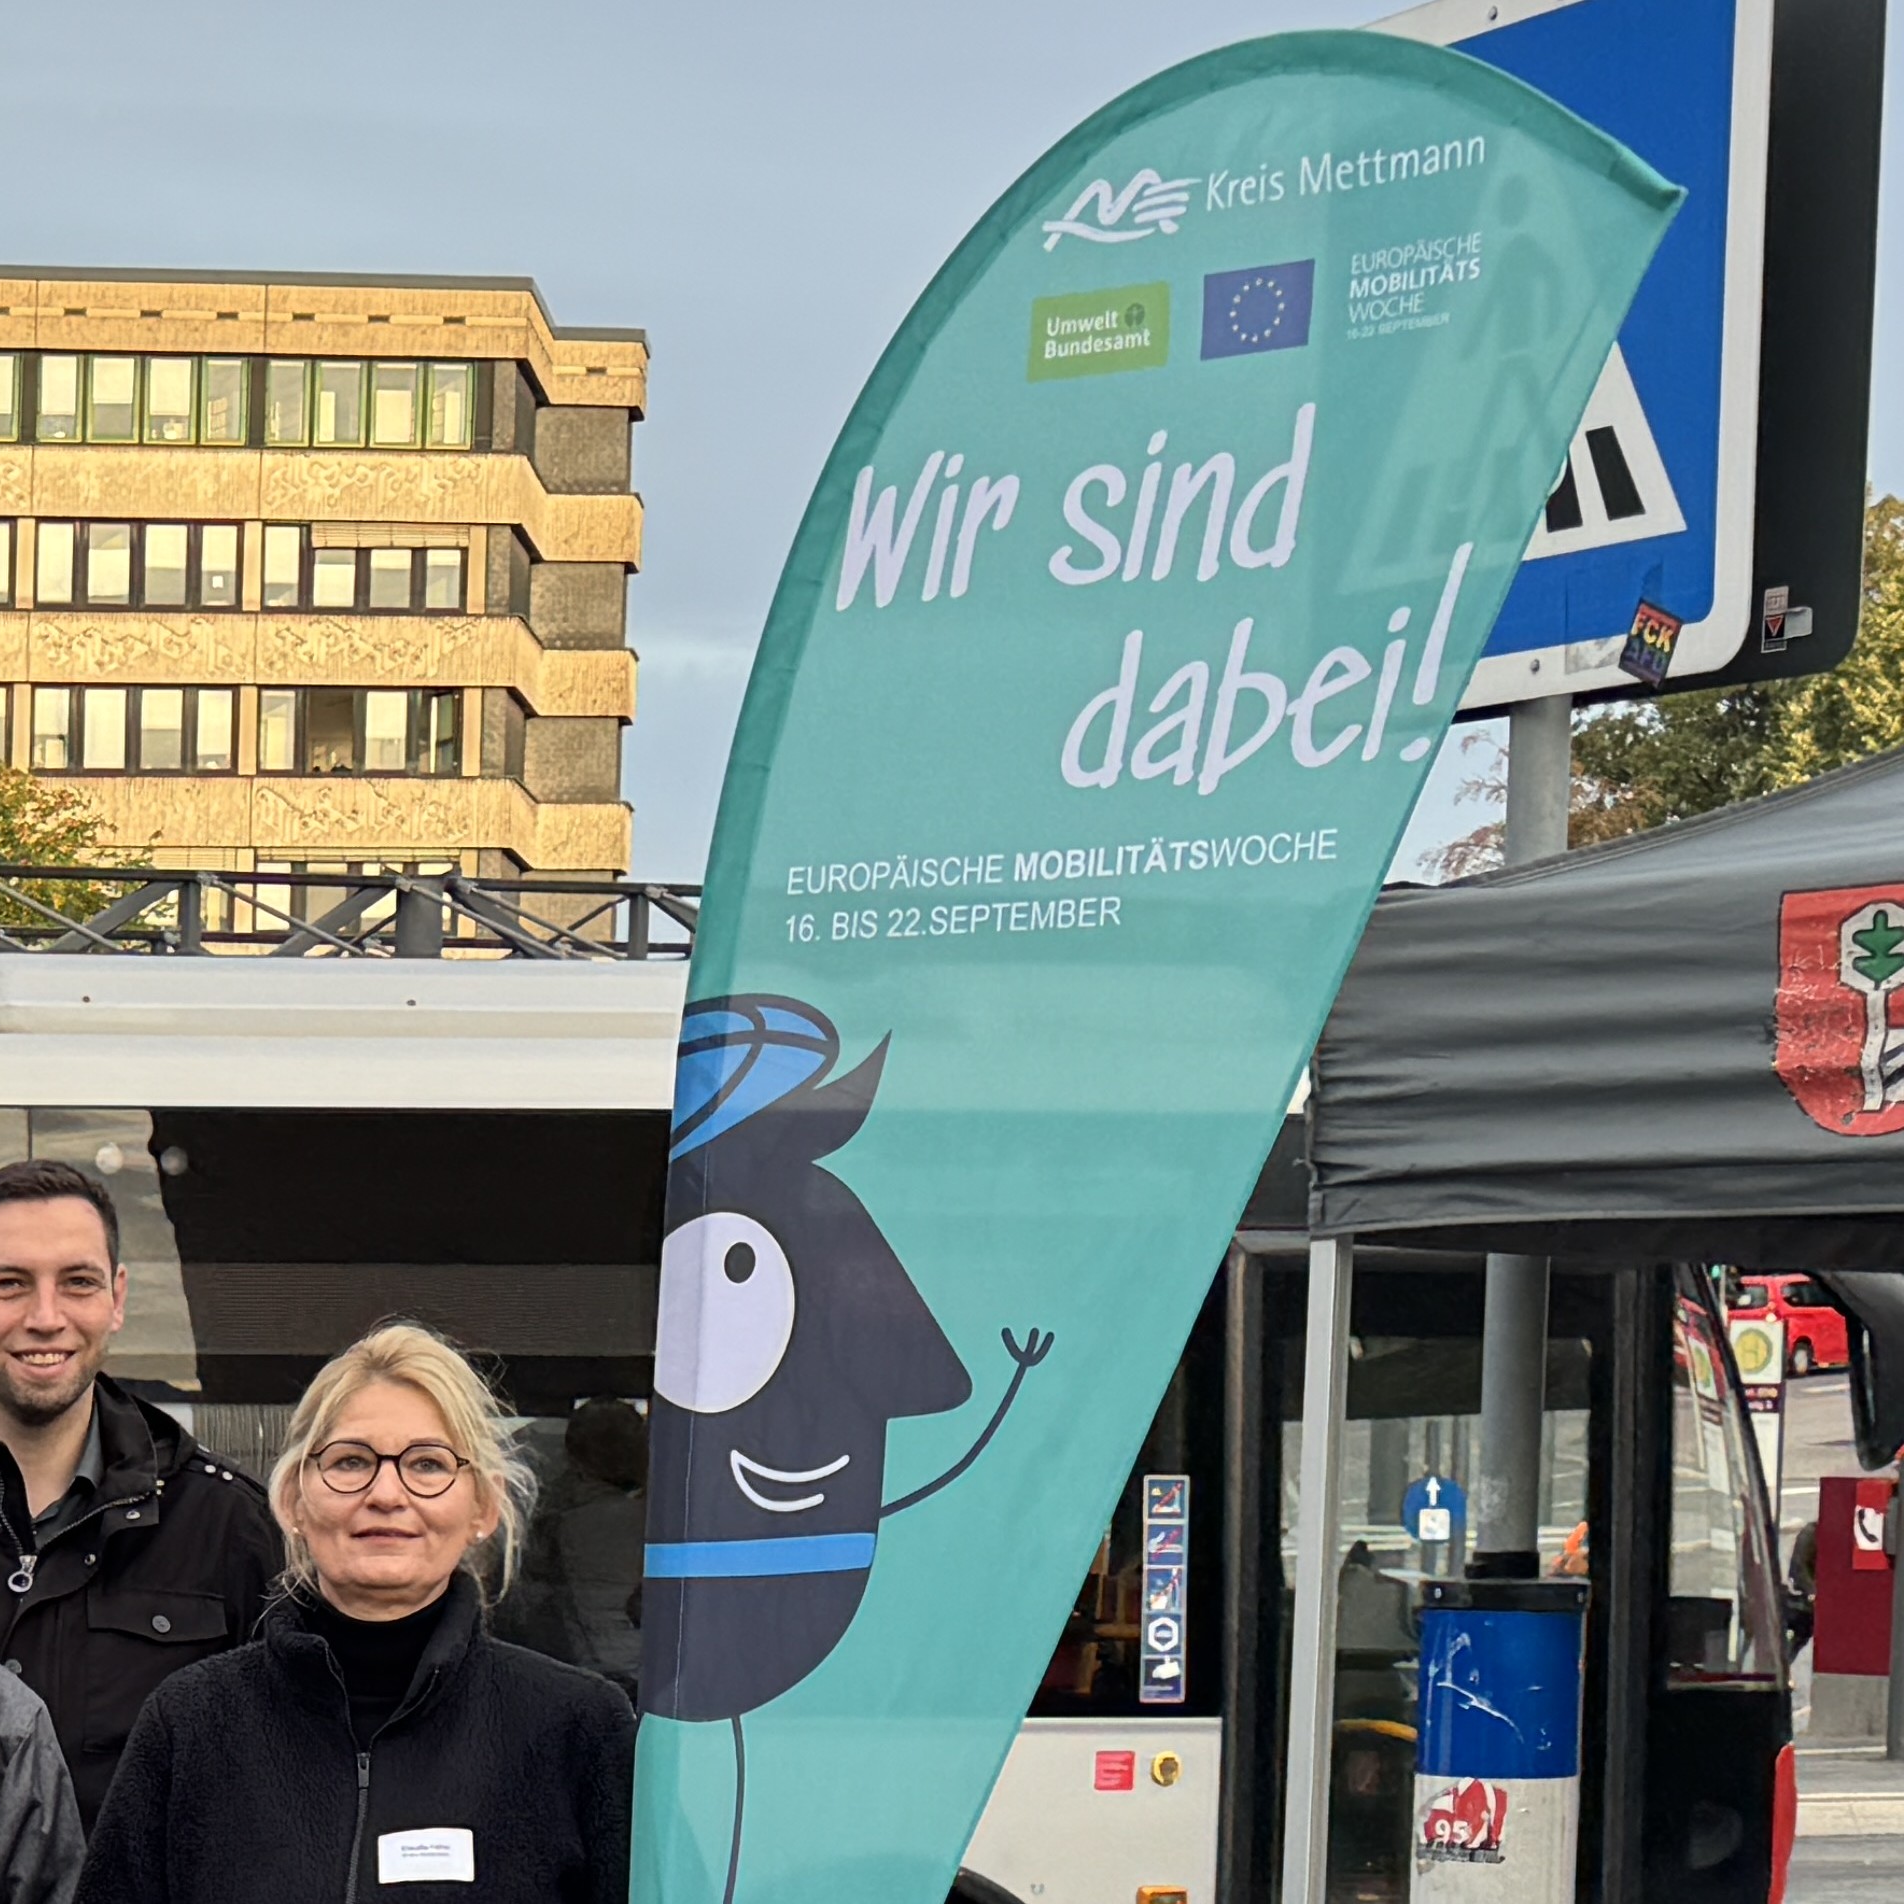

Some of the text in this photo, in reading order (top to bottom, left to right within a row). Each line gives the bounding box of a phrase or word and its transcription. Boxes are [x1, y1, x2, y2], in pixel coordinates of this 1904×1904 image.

[1205, 134, 1486, 211] Kreis Mettmann
[1351, 231, 1482, 275] EUROPÄISCHE
[1349, 256, 1481, 299] MOBILITÄTS
[1046, 310, 1119, 336] Umwelt
[1348, 291, 1425, 324] WOCHE
[1044, 329, 1151, 359] Bundesamt
[836, 402, 1316, 611] Wir sind
[1631, 612, 1673, 653] FCK
[1060, 541, 1474, 796] dabei!
[786, 828, 1339, 895] EUROPÄISCHE MOBILITÄTSWOCHE
[785, 914, 822, 944] 16.
[831, 910, 879, 941] BIS
